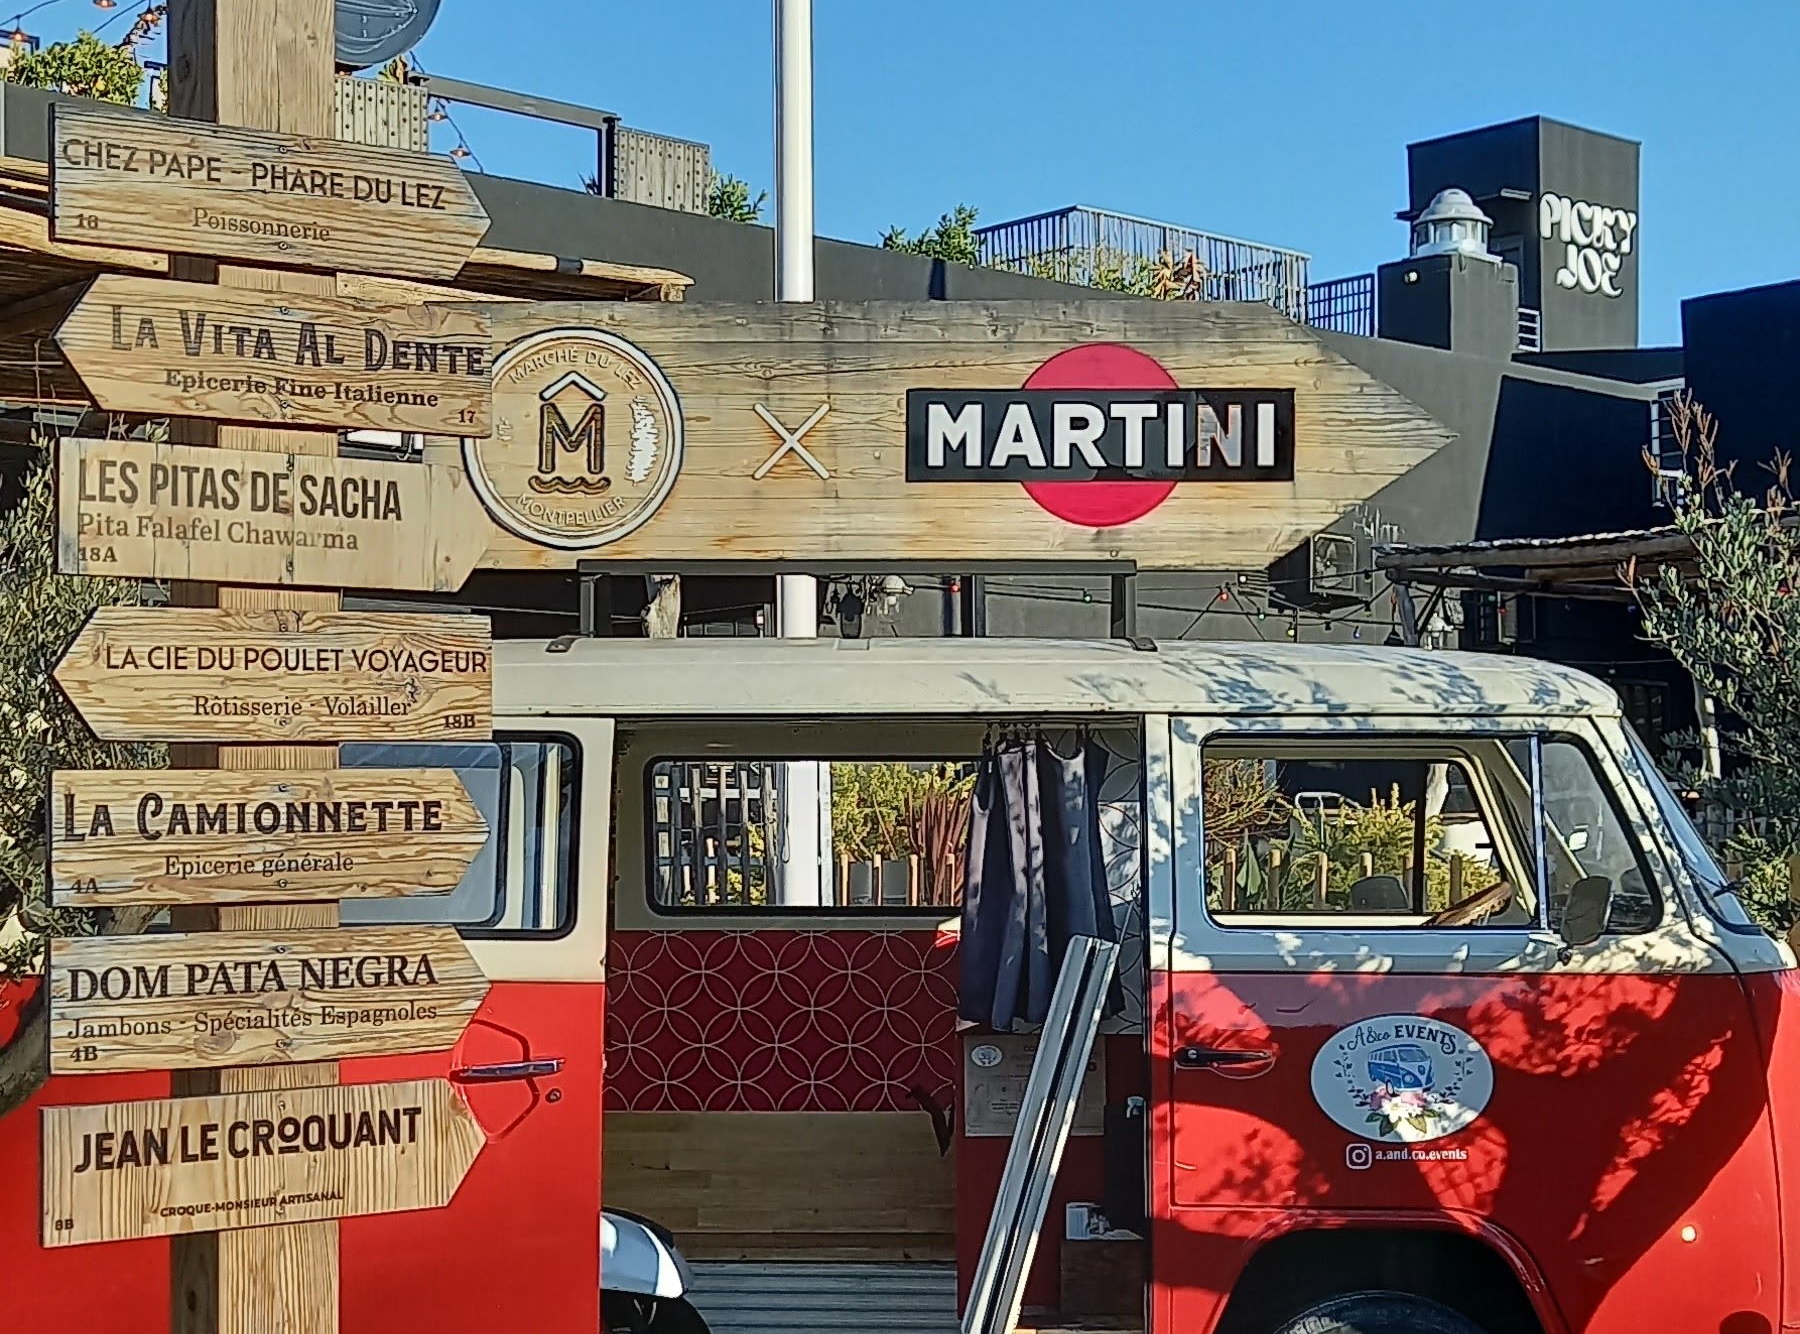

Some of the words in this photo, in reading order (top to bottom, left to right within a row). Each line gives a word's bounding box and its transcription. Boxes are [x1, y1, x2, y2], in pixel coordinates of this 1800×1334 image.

[62, 138, 140, 173] CHEZ
[148, 148, 221, 183] PAPE
[251, 162, 345, 199] PHARE
[353, 174, 392, 204] DU
[399, 180, 448, 210] LEZ
[191, 207, 331, 243] Poissonnerie
[1540, 193, 1637, 253] PICKY
[1556, 243, 1623, 297] JOE
[584, 350, 611, 369] DU
[614, 363, 643, 391] LEZ
[165, 369, 268, 398] Epicerie
[274, 378, 328, 400] Fine
[334, 380, 440, 409] Italienne
[457, 409, 477, 424] 17
[926, 402, 1276, 468] MARTINI
[78, 458, 140, 505] LES
[149, 463, 241, 512] PITAS
[251, 471, 292, 515] DE
[299, 474, 403, 522] SACHA
[517, 492, 626, 526] MONTPELLIER
[78, 512, 130, 538] Pita
[136, 515, 221, 543] Falafel
[228, 523, 360, 552] Chawarma
[78, 545, 119, 564] 18A
[105, 646, 140, 671] LA
[147, 646, 191, 671] CIE
[197, 646, 236, 671] DU
[244, 647, 345, 673] POULET
[351, 648, 488, 674] VOYAGEUR
[194, 694, 303, 717] Rôtisserie
[443, 714, 476, 729] 18B
[164, 855, 255, 879] Epicerie
[261, 852, 354, 878] générale
[70, 878, 100, 895] 4A
[67, 966, 172, 1003] DOM
[183, 961, 286, 996] PATA
[298, 952, 440, 992] NEGRA
[67, 1015, 172, 1041] Jambons
[194, 1007, 314, 1037] Spécialités
[319, 1000, 438, 1030] Espagnoles
[69, 1045, 99, 1062] 4B
[1394, 1025, 1457, 1055] EVENTS
[73, 1127, 169, 1174] JEAN
[180, 1123, 220, 1163] LE
[228, 1107, 422, 1160] CROQUANT
[160, 1198, 278, 1218] CROQUE-MONSIEUR
[279, 1190, 345, 1207] ARTISANAL
